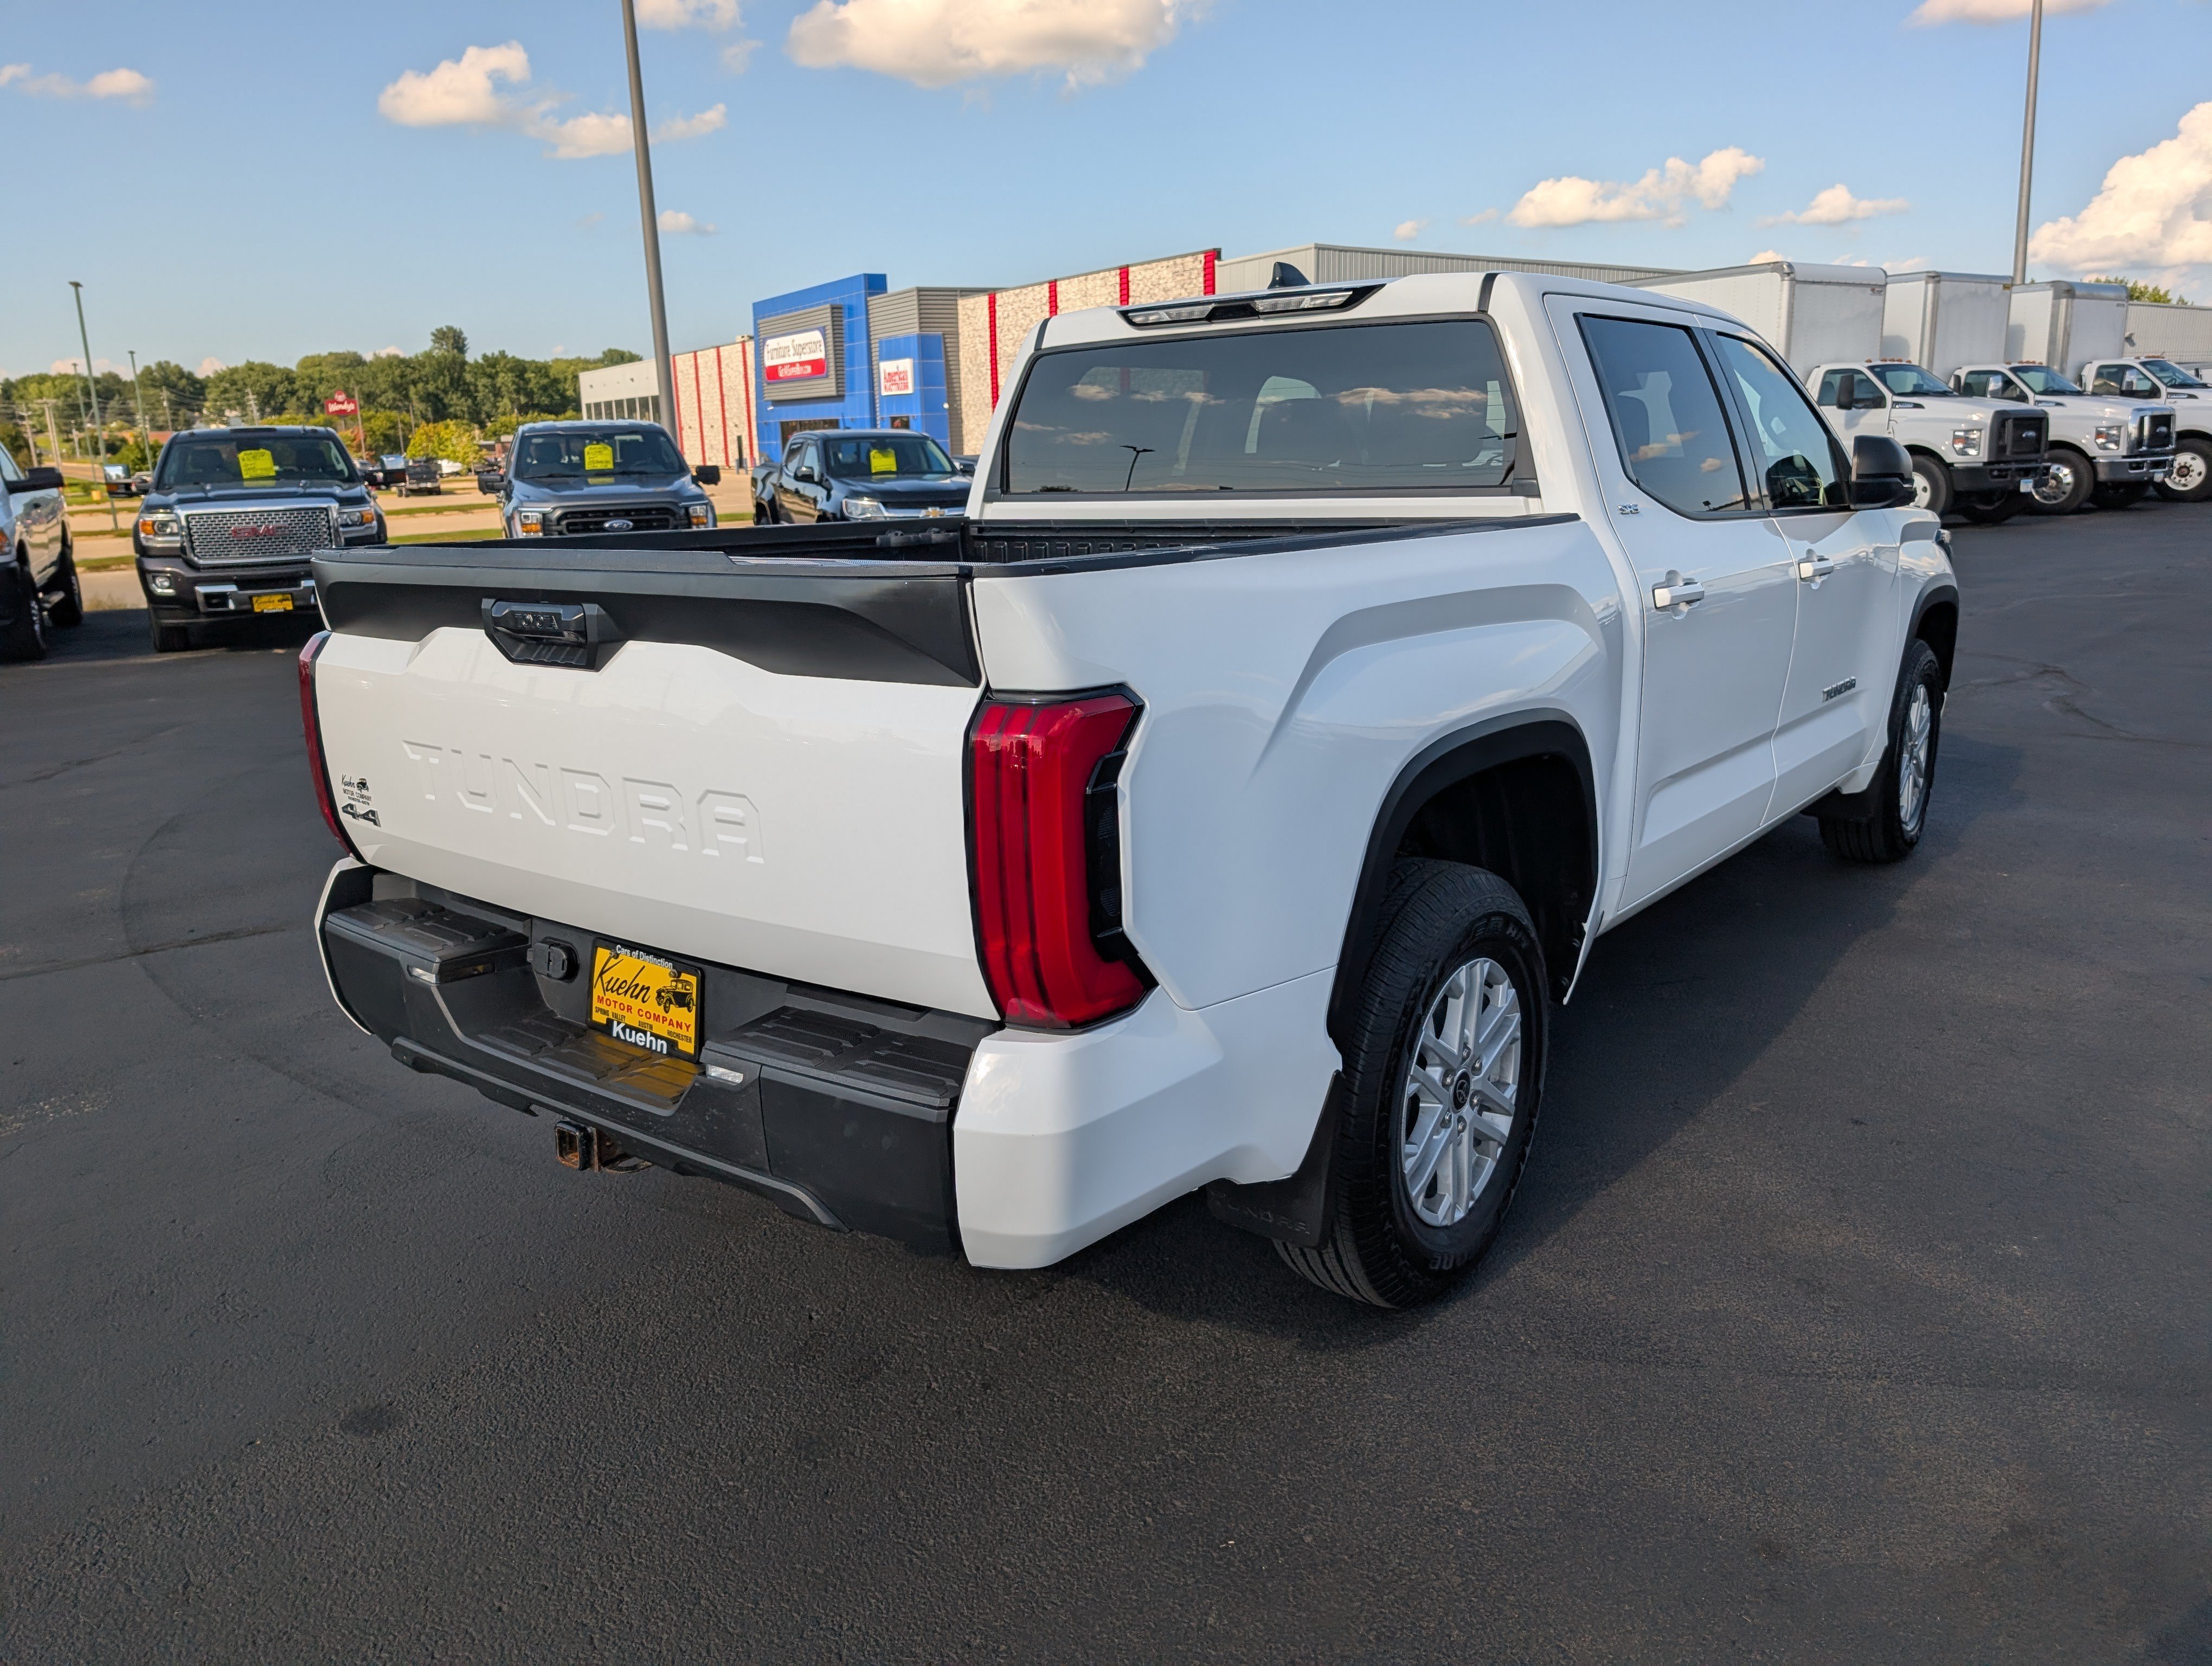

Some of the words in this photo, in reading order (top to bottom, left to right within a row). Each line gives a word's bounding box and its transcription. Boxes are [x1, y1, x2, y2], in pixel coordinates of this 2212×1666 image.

[766, 342, 791, 361] Furniture
[792, 339, 822, 359] Superstore
[328, 400, 355, 413] Wendy's
[231, 524, 290, 539] GMC
[515, 613, 559, 629] TOYOTA
[1822, 676, 1856, 703] TUNDRA
[341, 774, 356, 789] Kuehn
[343, 787, 355, 797] MOTOR
[355, 791, 372, 802] COMPANY
[402, 740, 764, 863] TUNDRA
[616, 944, 631, 957] Cars
[632, 950, 639, 959] of
[639, 951, 673, 970] Distinction
[594, 956, 651, 1004] Kuehn
[595, 1006, 610, 1016] SPRING
[612, 1011, 626, 1022] VALLEY
[597, 995, 633, 1014] MOTOR
[637, 1008, 692, 1032] COMPANY
[638, 1020, 653, 1031] AUSTIN
[612, 1020, 667, 1054] Kuehn
[667, 1029, 692, 1044] ROCHESTER
